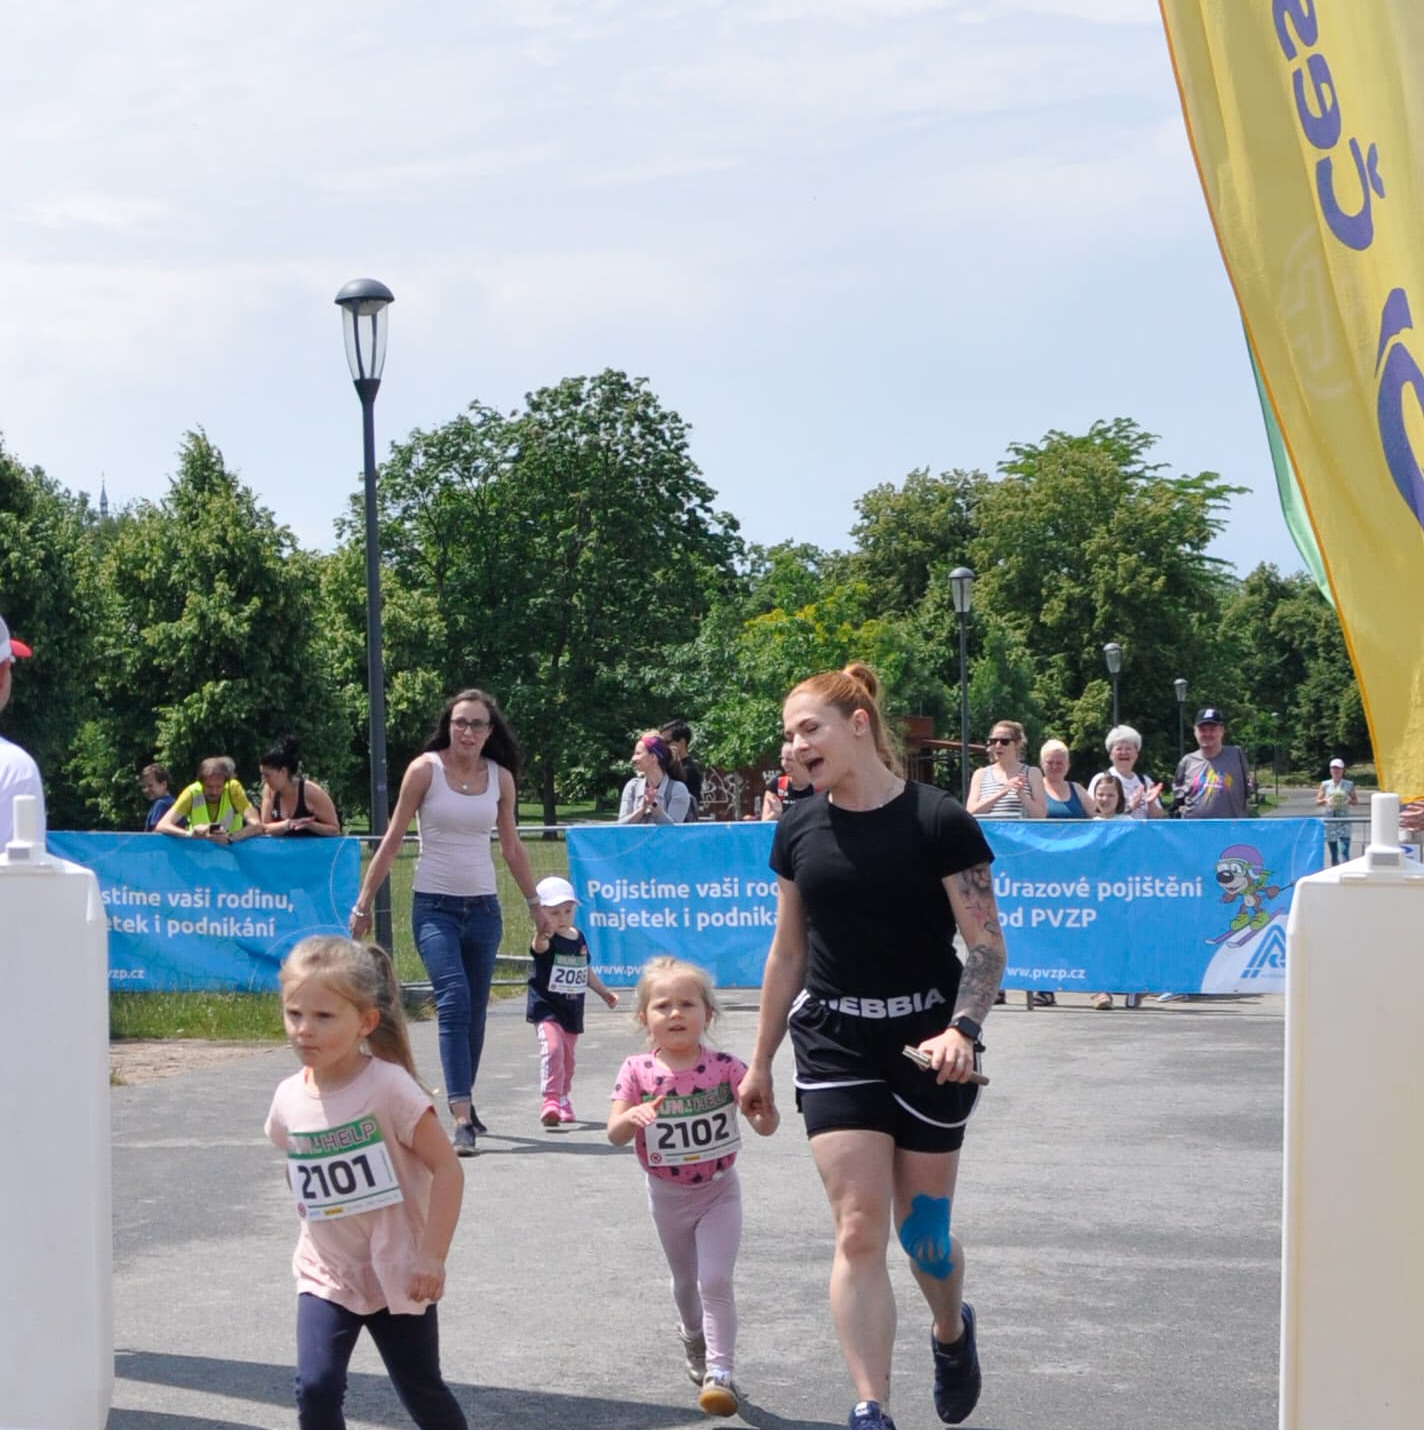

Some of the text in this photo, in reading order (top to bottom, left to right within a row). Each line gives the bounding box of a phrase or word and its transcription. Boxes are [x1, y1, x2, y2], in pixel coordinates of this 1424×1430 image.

[167, 887, 210, 908] vaši
[217, 888, 294, 913] rodinu,
[587, 878, 690, 903] Pojistíme
[696, 877, 739, 898] vaši
[994, 872, 1202, 902] Úrazové pojištění
[154, 915, 161, 933] i
[167, 916, 275, 939] podnikání
[589, 907, 678, 931] majetek
[684, 908, 691, 927] i
[1031, 908, 1097, 928] PVZP
[321, 1122, 376, 1151] HELP
[656, 1112, 730, 1150] 2102
[297, 1154, 376, 1199] 2101
